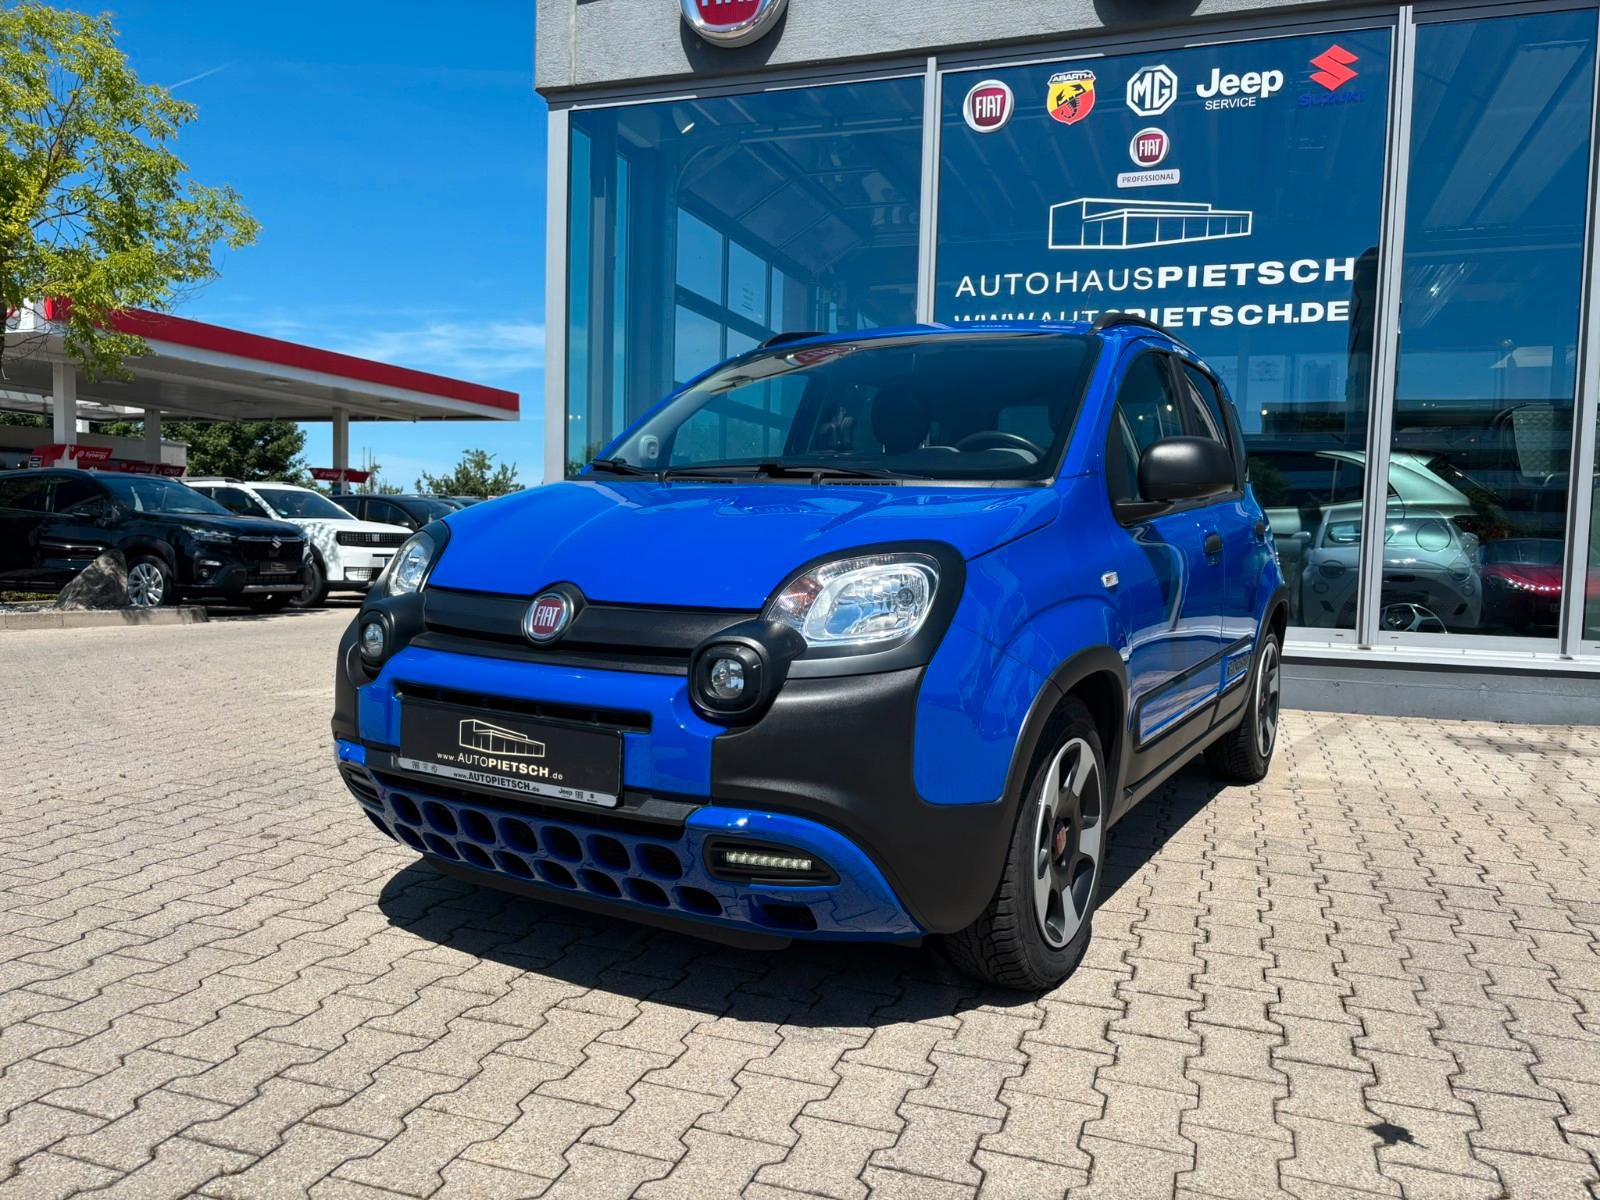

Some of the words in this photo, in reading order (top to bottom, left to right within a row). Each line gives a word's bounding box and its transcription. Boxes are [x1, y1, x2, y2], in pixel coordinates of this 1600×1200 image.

[1052, 73, 1092, 82] ABARTH
[1196, 68, 1284, 98] Jeep
[1133, 71, 1171, 109] MG
[975, 94, 1003, 118] FIAT
[1205, 97, 1257, 110] SERVICE
[1139, 138, 1162, 157] FIAT
[1122, 172, 1175, 184] PROFESSIONAL
[955, 257, 1355, 298] AUTOHAUSPIETSCH
[533, 605, 561, 627] FIAT
